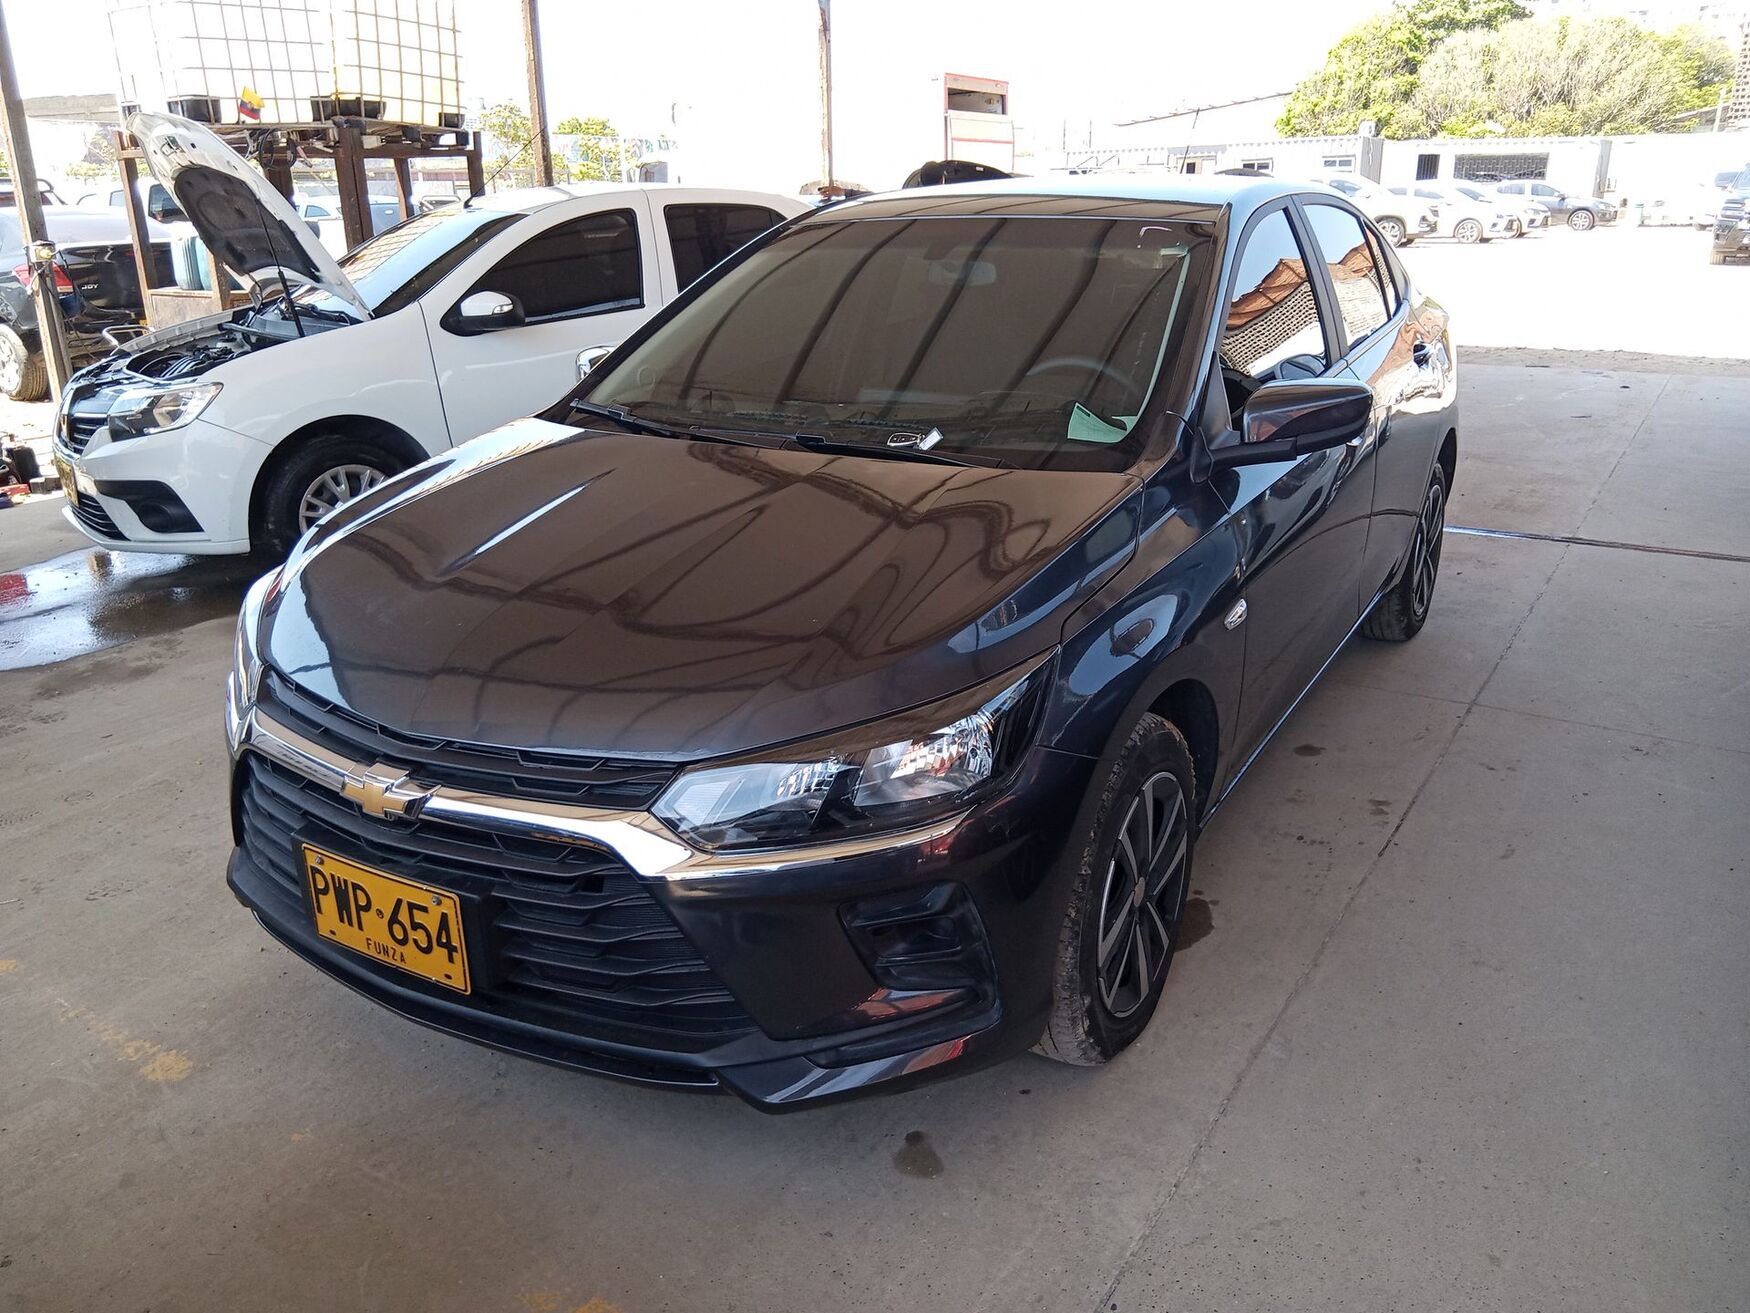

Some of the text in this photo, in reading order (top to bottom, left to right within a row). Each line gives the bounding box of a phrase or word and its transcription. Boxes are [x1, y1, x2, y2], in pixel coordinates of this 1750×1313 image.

[310, 865, 458, 964] PWP 654
[365, 937, 407, 965] FUNZA
